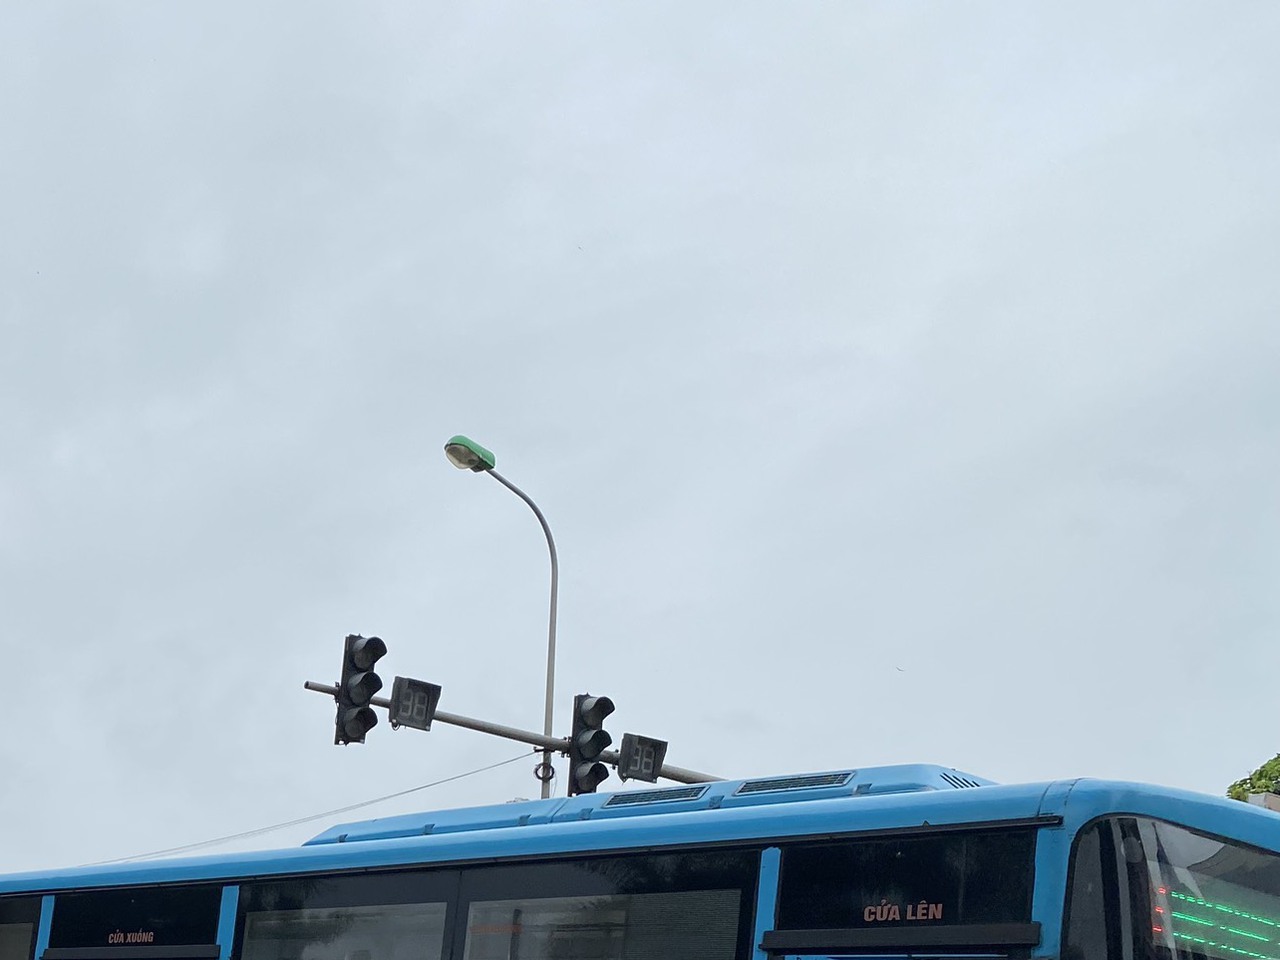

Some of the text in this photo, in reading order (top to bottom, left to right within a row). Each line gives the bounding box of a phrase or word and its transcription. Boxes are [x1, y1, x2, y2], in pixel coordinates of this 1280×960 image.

[863, 899, 943, 921] CỬA LÊN
[108, 928, 154, 943] CỬA XUỐNG
